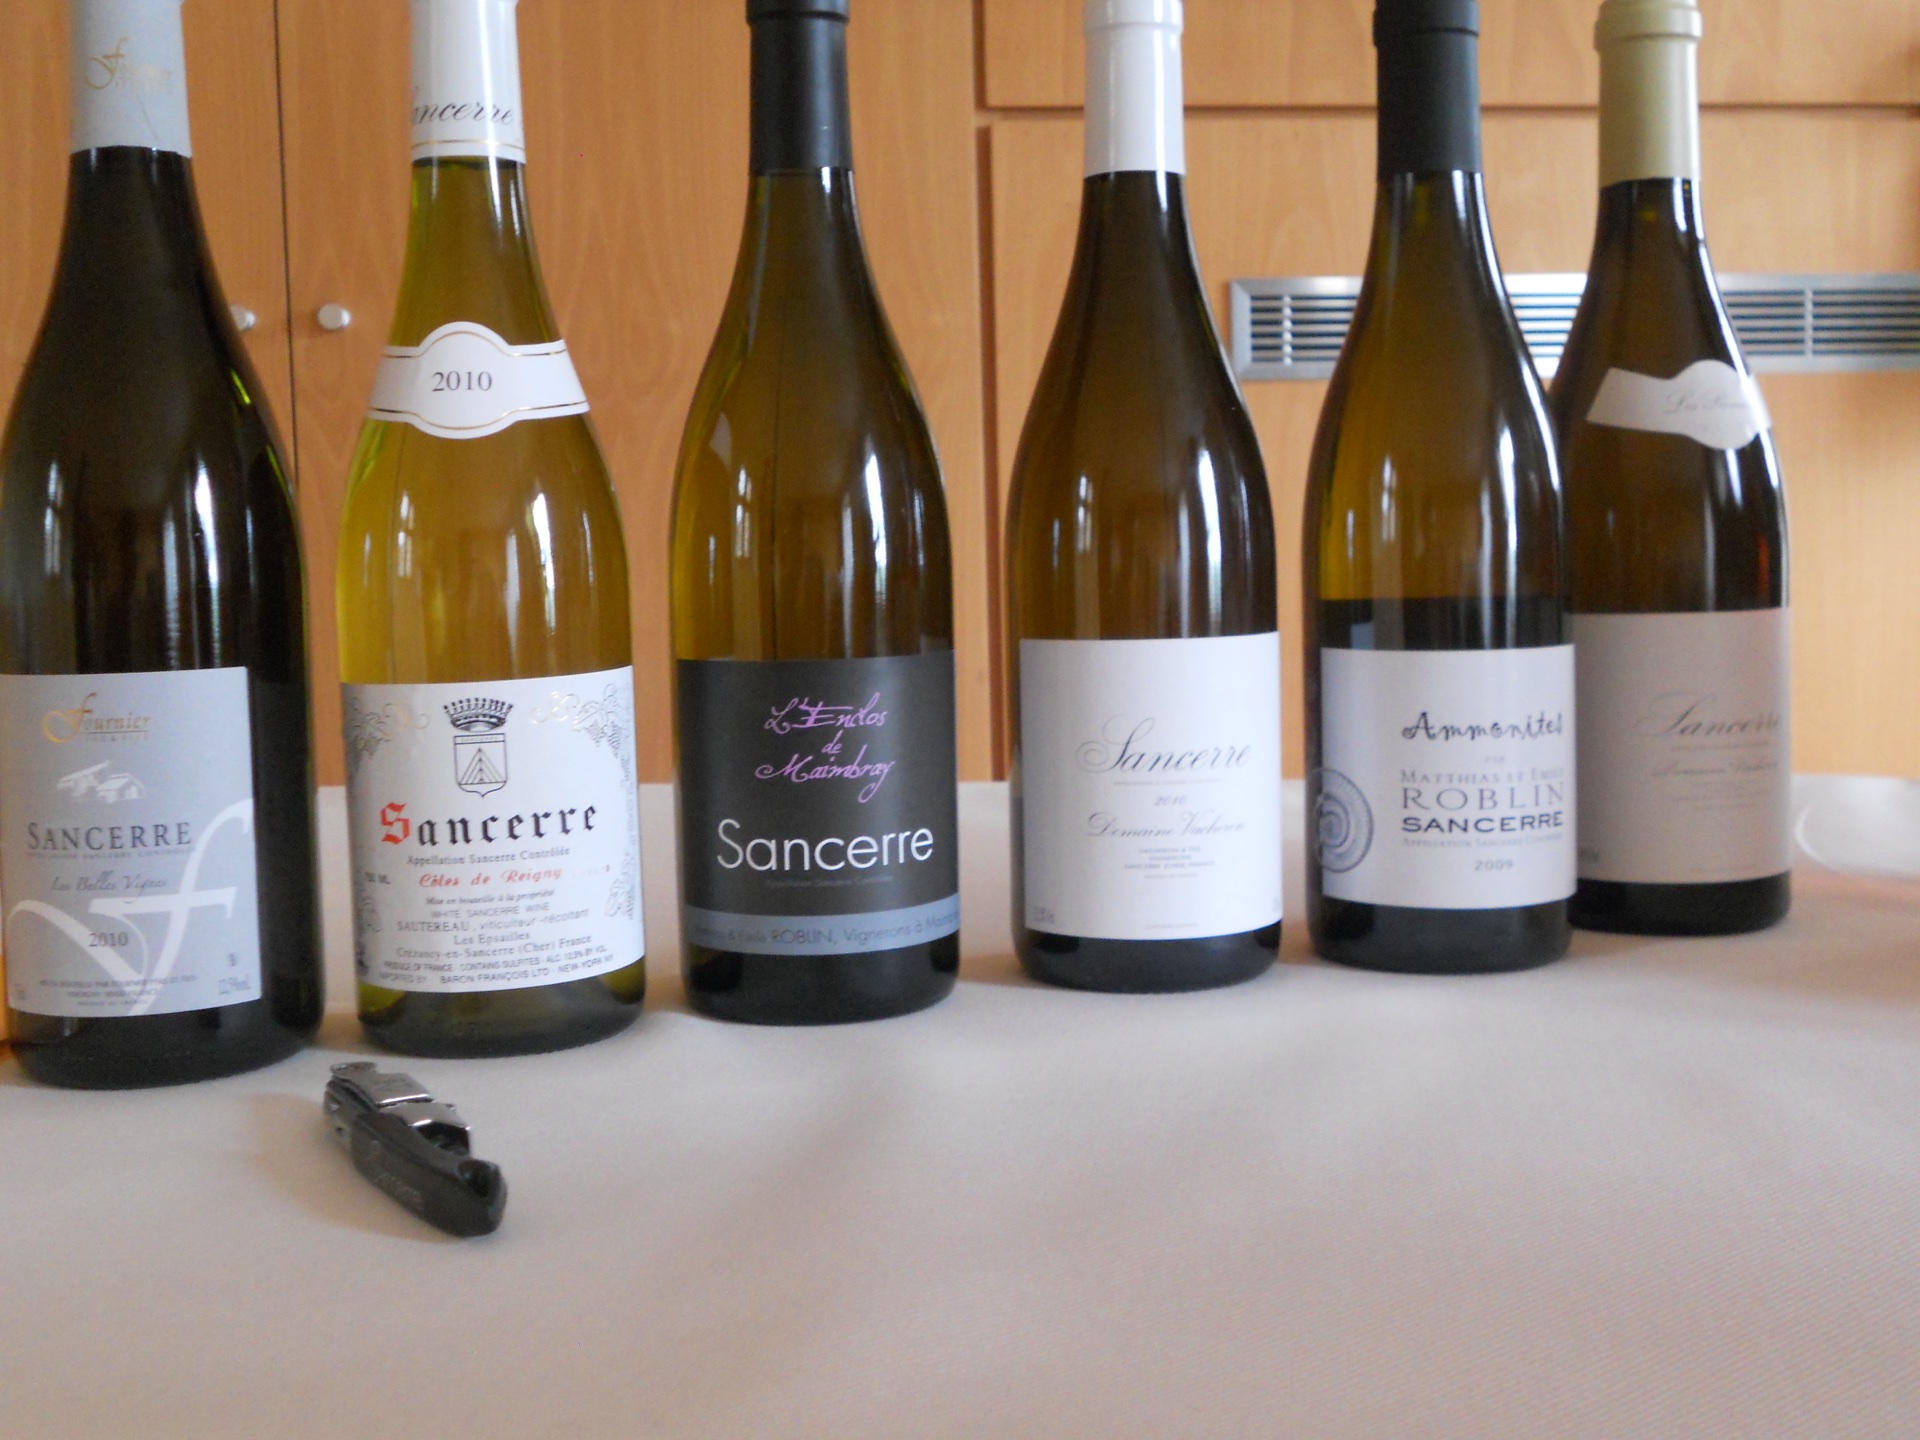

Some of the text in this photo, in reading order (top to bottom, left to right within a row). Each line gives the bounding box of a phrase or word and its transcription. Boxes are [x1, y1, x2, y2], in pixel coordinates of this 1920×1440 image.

[413, 100, 514, 125] ncerre
[432, 370, 493, 392] 2010
[821, 730, 843, 755] de
[1075, 714, 1251, 774] Sancerre
[755, 744, 896, 803] Maimbray
[1154, 794, 1189, 807] 2010
[1402, 781, 1563, 810] ROBLIN
[380, 802, 597, 847] Sancerre
[1401, 811, 1563, 833] SANCERRE
[28, 821, 192, 850] SANCERRE
[717, 818, 934, 871] Sancerre
[469, 851, 516, 864] Sancerre
[1474, 859, 1514, 872] 2009
[470, 872, 491, 886] de
[88, 931, 129, 948] 2010
[453, 934, 474, 945] Les
[558, 935, 592, 948] France
